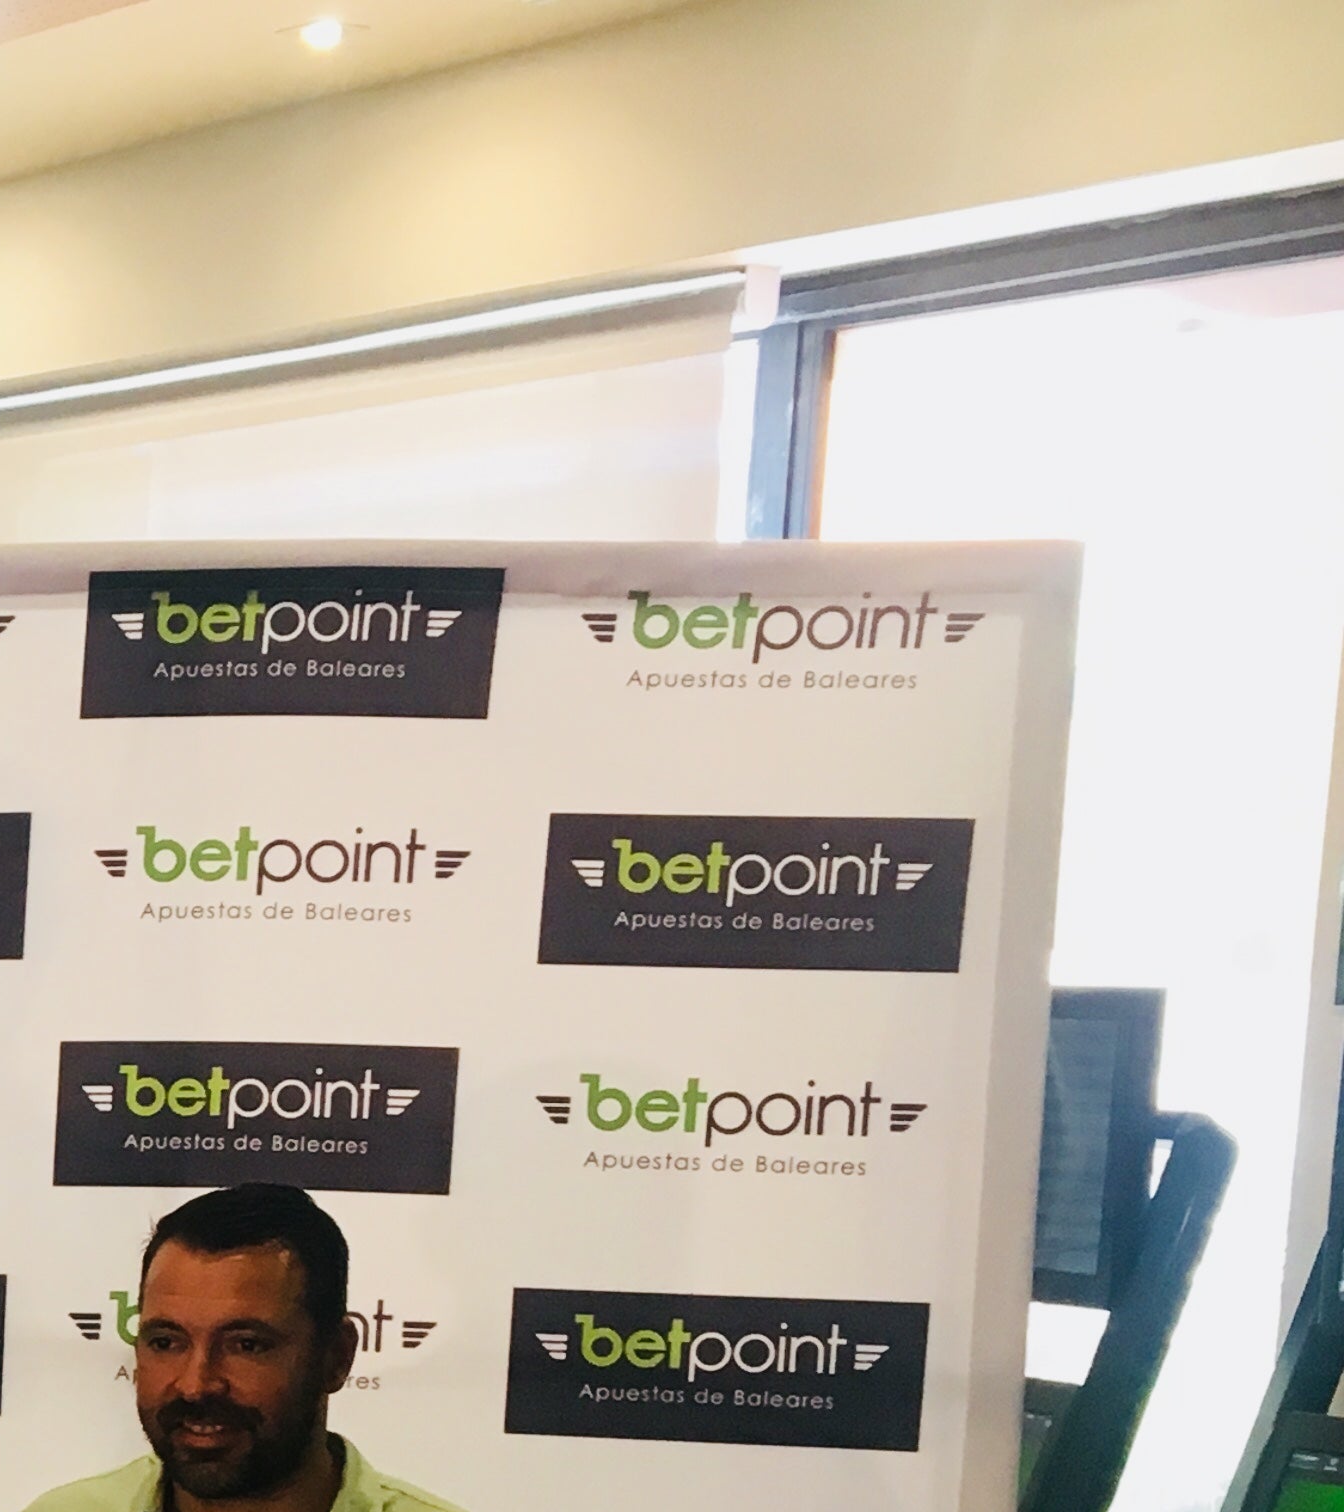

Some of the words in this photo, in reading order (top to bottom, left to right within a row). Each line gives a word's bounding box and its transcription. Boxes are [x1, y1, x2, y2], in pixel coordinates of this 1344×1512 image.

[151, 592, 420, 654] betpoint
[628, 592, 939, 663] betpoint
[153, 660, 257, 681] Apuestas
[268, 659, 297, 678] de
[307, 659, 405, 678] Baleares
[626, 670, 748, 692] Apuestas
[758, 670, 792, 688] de
[804, 670, 917, 690] Baleares
[136, 826, 426, 895] betpoint
[613, 839, 889, 906] betpoint
[141, 902, 249, 924] Apuestas
[260, 903, 290, 921] de
[300, 904, 411, 924] Baleares
[614, 910, 722, 932] Apuestas
[733, 912, 762, 930] de
[773, 913, 874, 932] Baleares
[121, 1066, 380, 1128] betpoint
[580, 1074, 882, 1146] betpoint
[124, 1134, 224, 1155] Apuestas
[235, 1135, 262, 1152] de
[271, 1136, 367, 1155] Baleares
[584, 1152, 701, 1174] Apuestas
[712, 1153, 743, 1173] de
[755, 1156, 866, 1177] Baleares
[575, 1314, 847, 1382] betpoint
[578, 1384, 684, 1405] Apuestas
[694, 1386, 724, 1405] de
[734, 1388, 834, 1409] Baleares
